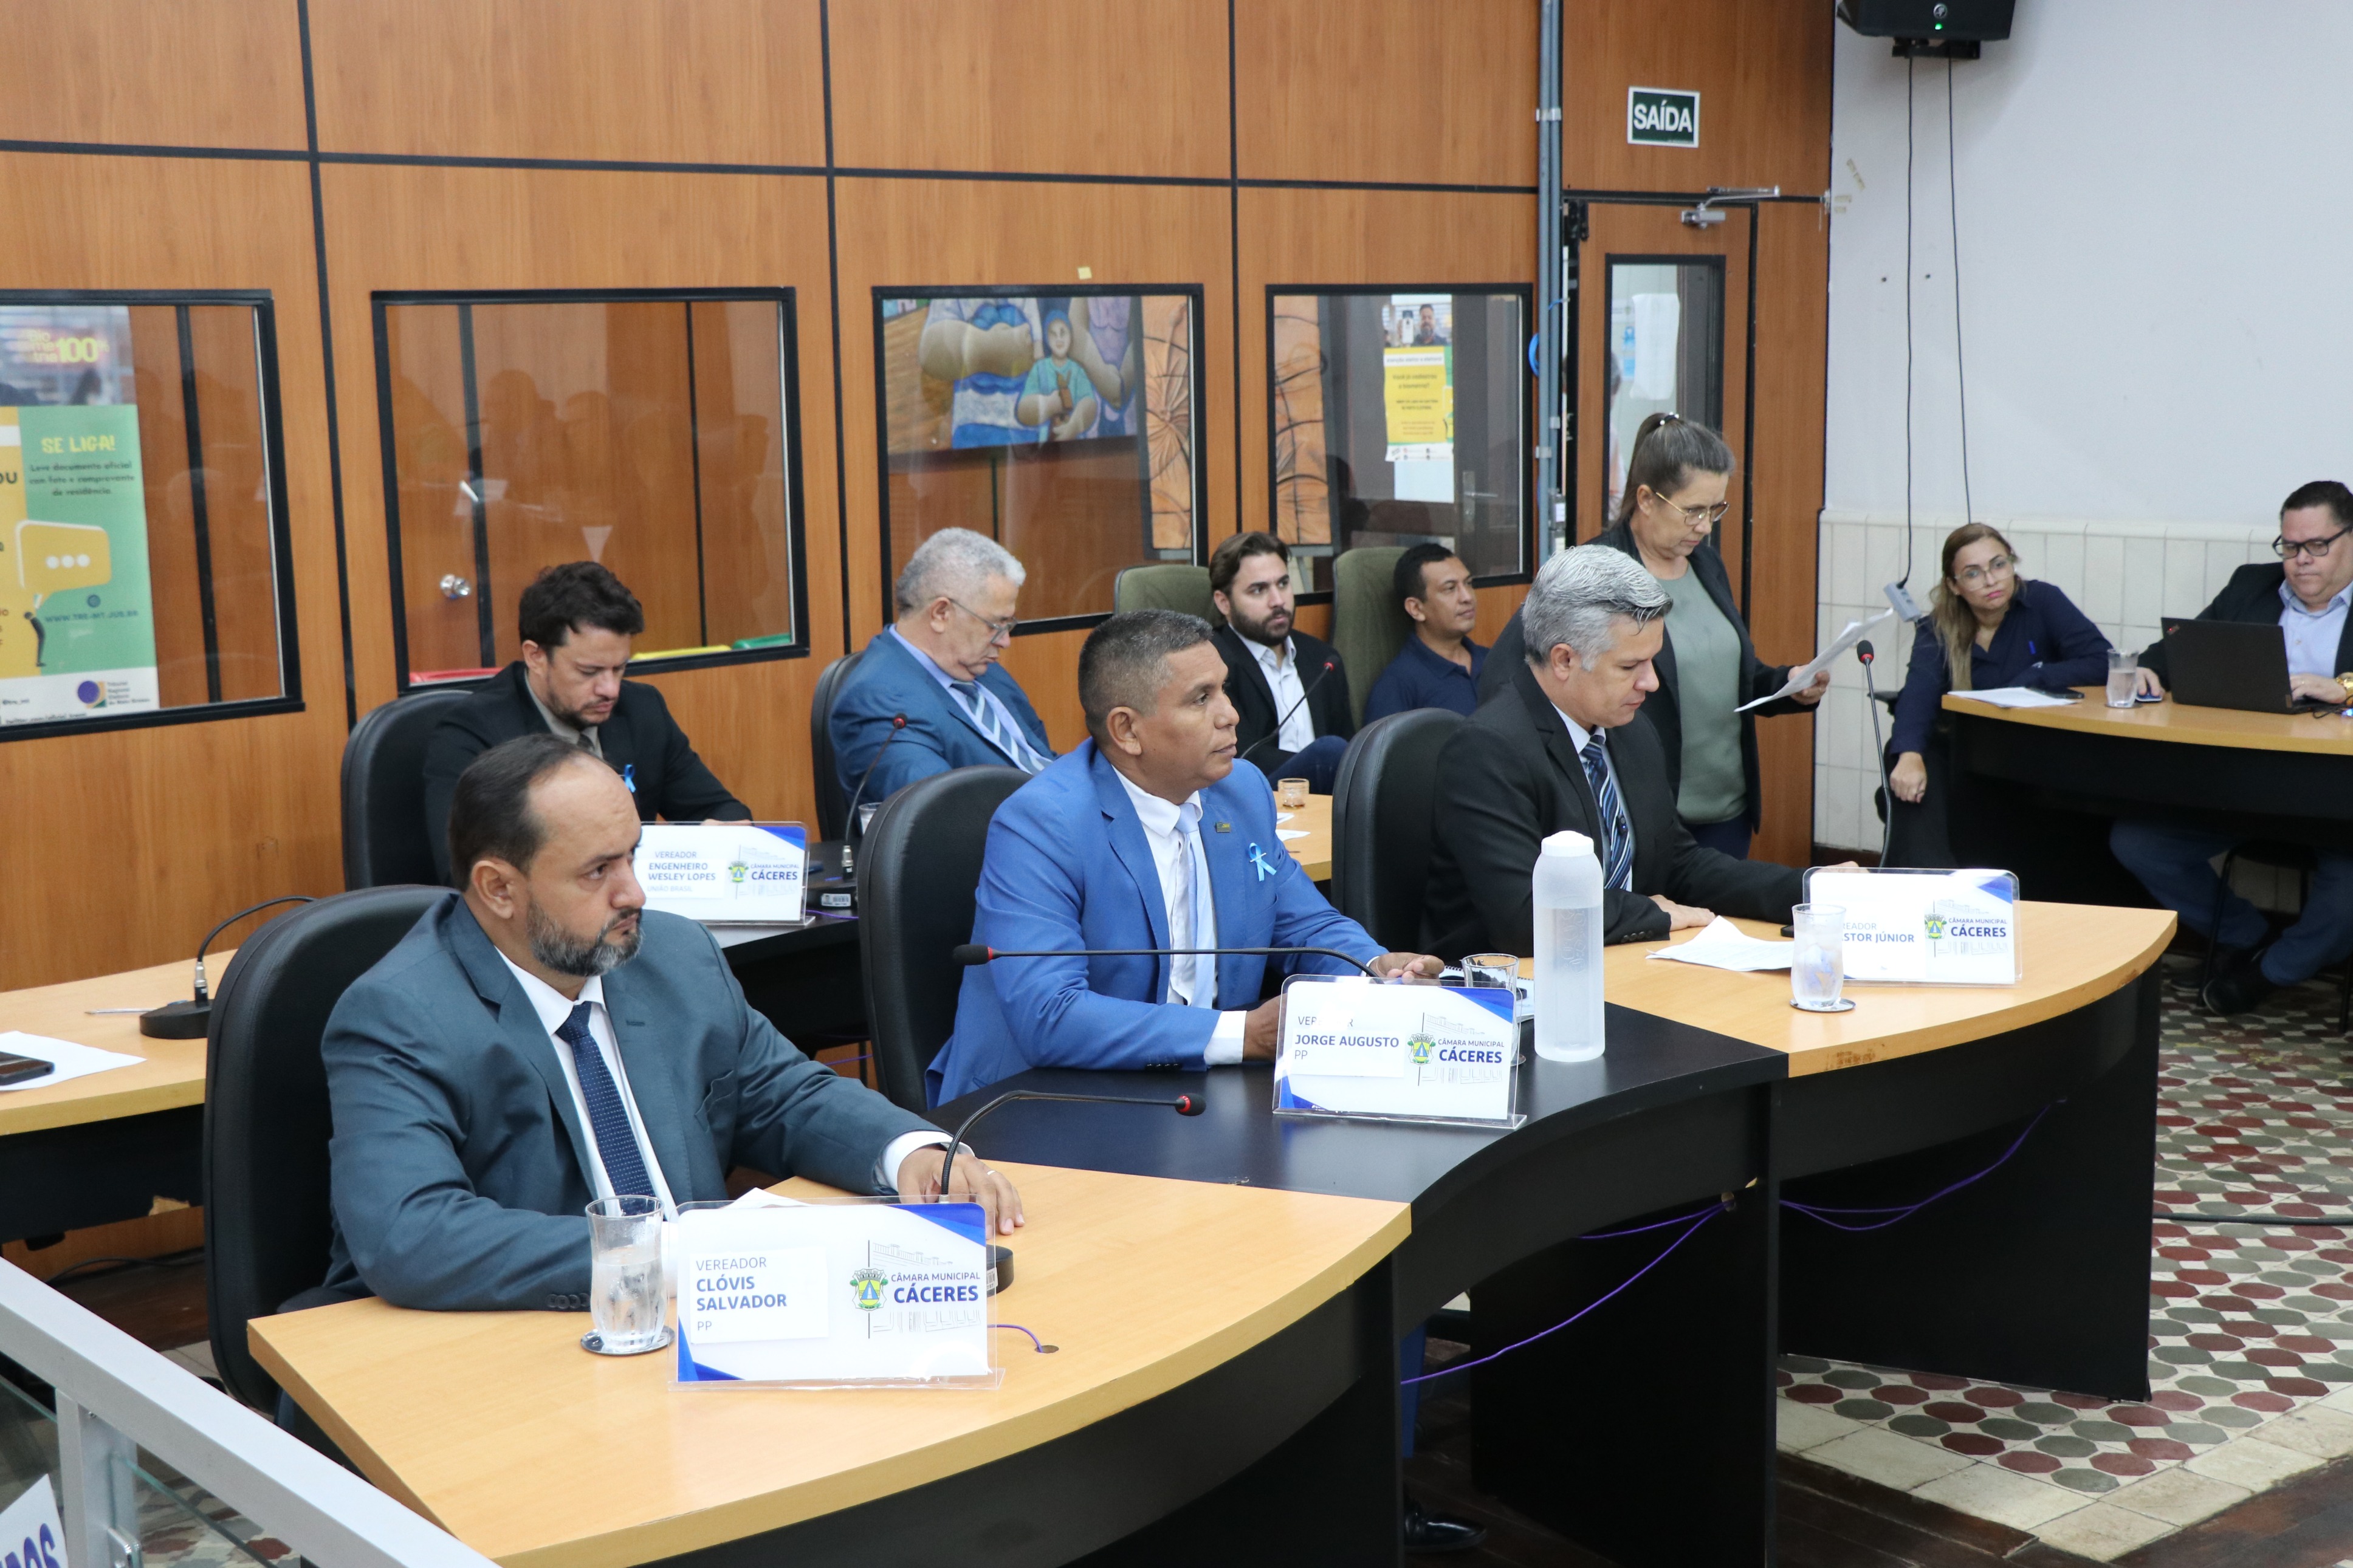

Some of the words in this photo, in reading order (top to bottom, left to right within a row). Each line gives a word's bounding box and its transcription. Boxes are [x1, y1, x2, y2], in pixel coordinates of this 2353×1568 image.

[1633, 100, 1693, 132] SAÍDA
[41, 437, 63, 453] SE
[69, 435, 115, 452] LIGA!
[78, 475, 135, 484] comprovante
[752, 869, 798, 880] CÁCERES
[1875, 931, 1914, 943] JÚNIOR
[1951, 924, 2006, 937] CÁCERES
[1295, 1035, 1336, 1046] JORGE
[1339, 1036, 1400, 1047] AUGUSTO
[1294, 1050, 1308, 1060] PP
[1439, 1046, 1502, 1063] CÁCERES
[696, 1257, 767, 1271] VEREADOR
[696, 1274, 755, 1292] CLÓVIS
[891, 1272, 929, 1282] CÂMARA
[932, 1272, 980, 1281] MUNICIPAL
[894, 1282, 978, 1303] CÁCERES
[696, 1293, 787, 1311] SALVADOR
[698, 1321, 712, 1331] PP
